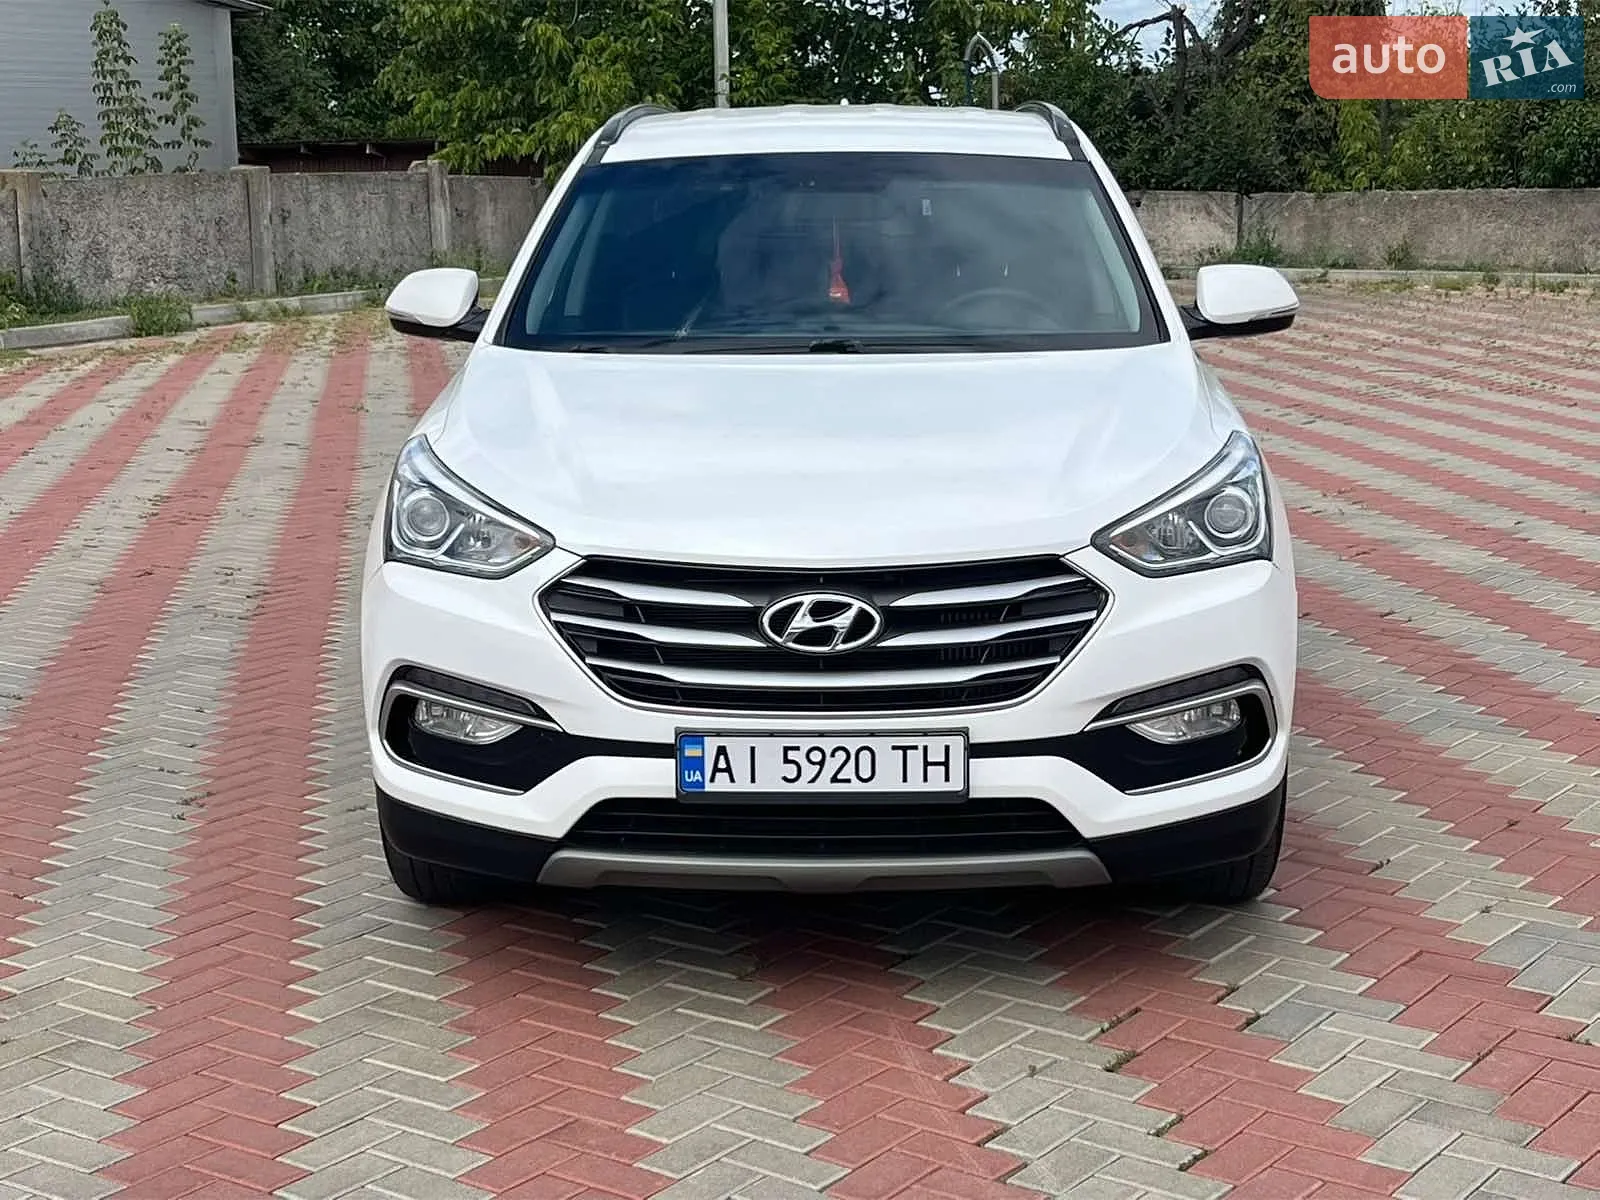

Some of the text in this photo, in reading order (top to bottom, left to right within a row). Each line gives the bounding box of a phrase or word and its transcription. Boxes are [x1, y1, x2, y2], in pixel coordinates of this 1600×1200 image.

[684, 770, 703, 783] UA
[709, 744, 951, 784] AI 5920 TH
